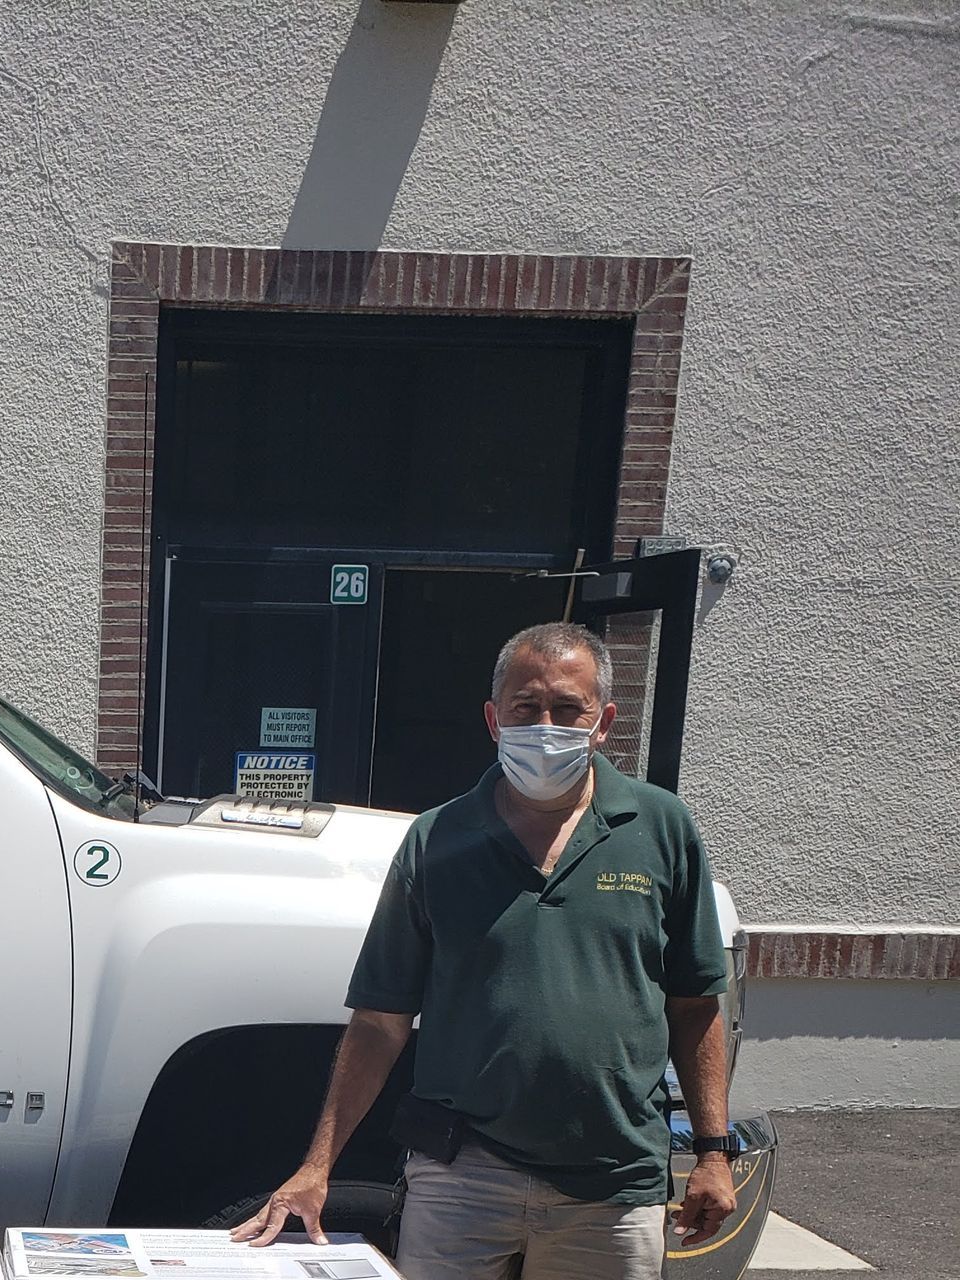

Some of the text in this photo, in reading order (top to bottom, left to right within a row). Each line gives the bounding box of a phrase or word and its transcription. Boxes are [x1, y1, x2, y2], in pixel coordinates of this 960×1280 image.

[335, 572, 364, 597] 26
[268, 712, 310, 721] ALL VISITORS
[266, 723, 310, 732] MUST REPORT
[263, 734, 312, 743] TO MAIN OFFICE
[243, 757, 308, 769] NOTICE
[297, 782, 309, 790] BY
[246, 790, 303, 798] ELECTRONIC
[86, 846, 109, 879] 2
[597, 872, 653, 886] OLD TAPPAN
